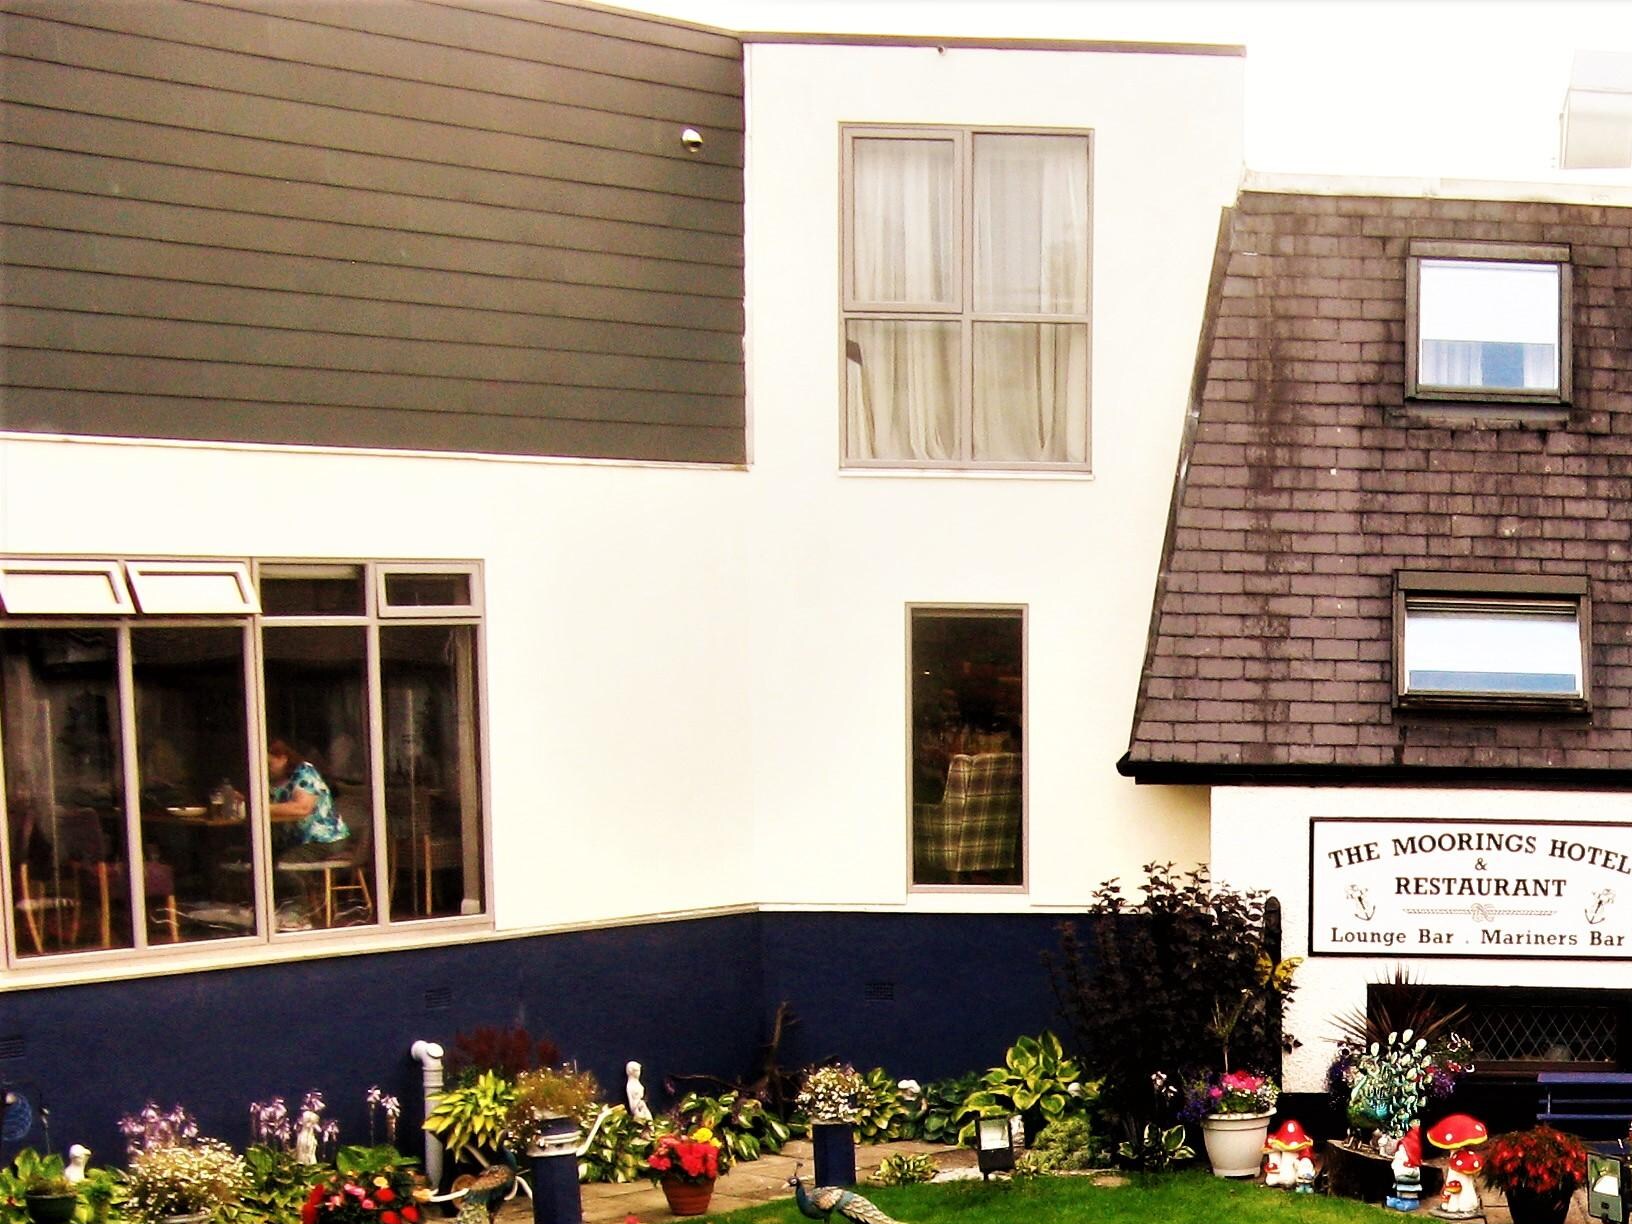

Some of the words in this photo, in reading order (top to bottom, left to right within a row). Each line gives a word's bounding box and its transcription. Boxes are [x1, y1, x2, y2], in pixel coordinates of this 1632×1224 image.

[1327, 841, 1381, 869] THE
[1392, 832, 1537, 857] MOORINGS
[1548, 838, 1632, 875] HOTEL
[1474, 857, 1488, 871] &
[1394, 876, 1567, 897] RESTAURANT
[1331, 927, 1407, 946] Lounge
[1418, 928, 1454, 944] Bar
[1481, 929, 1578, 946] Mariners
[1589, 930, 1626, 947] Bar
